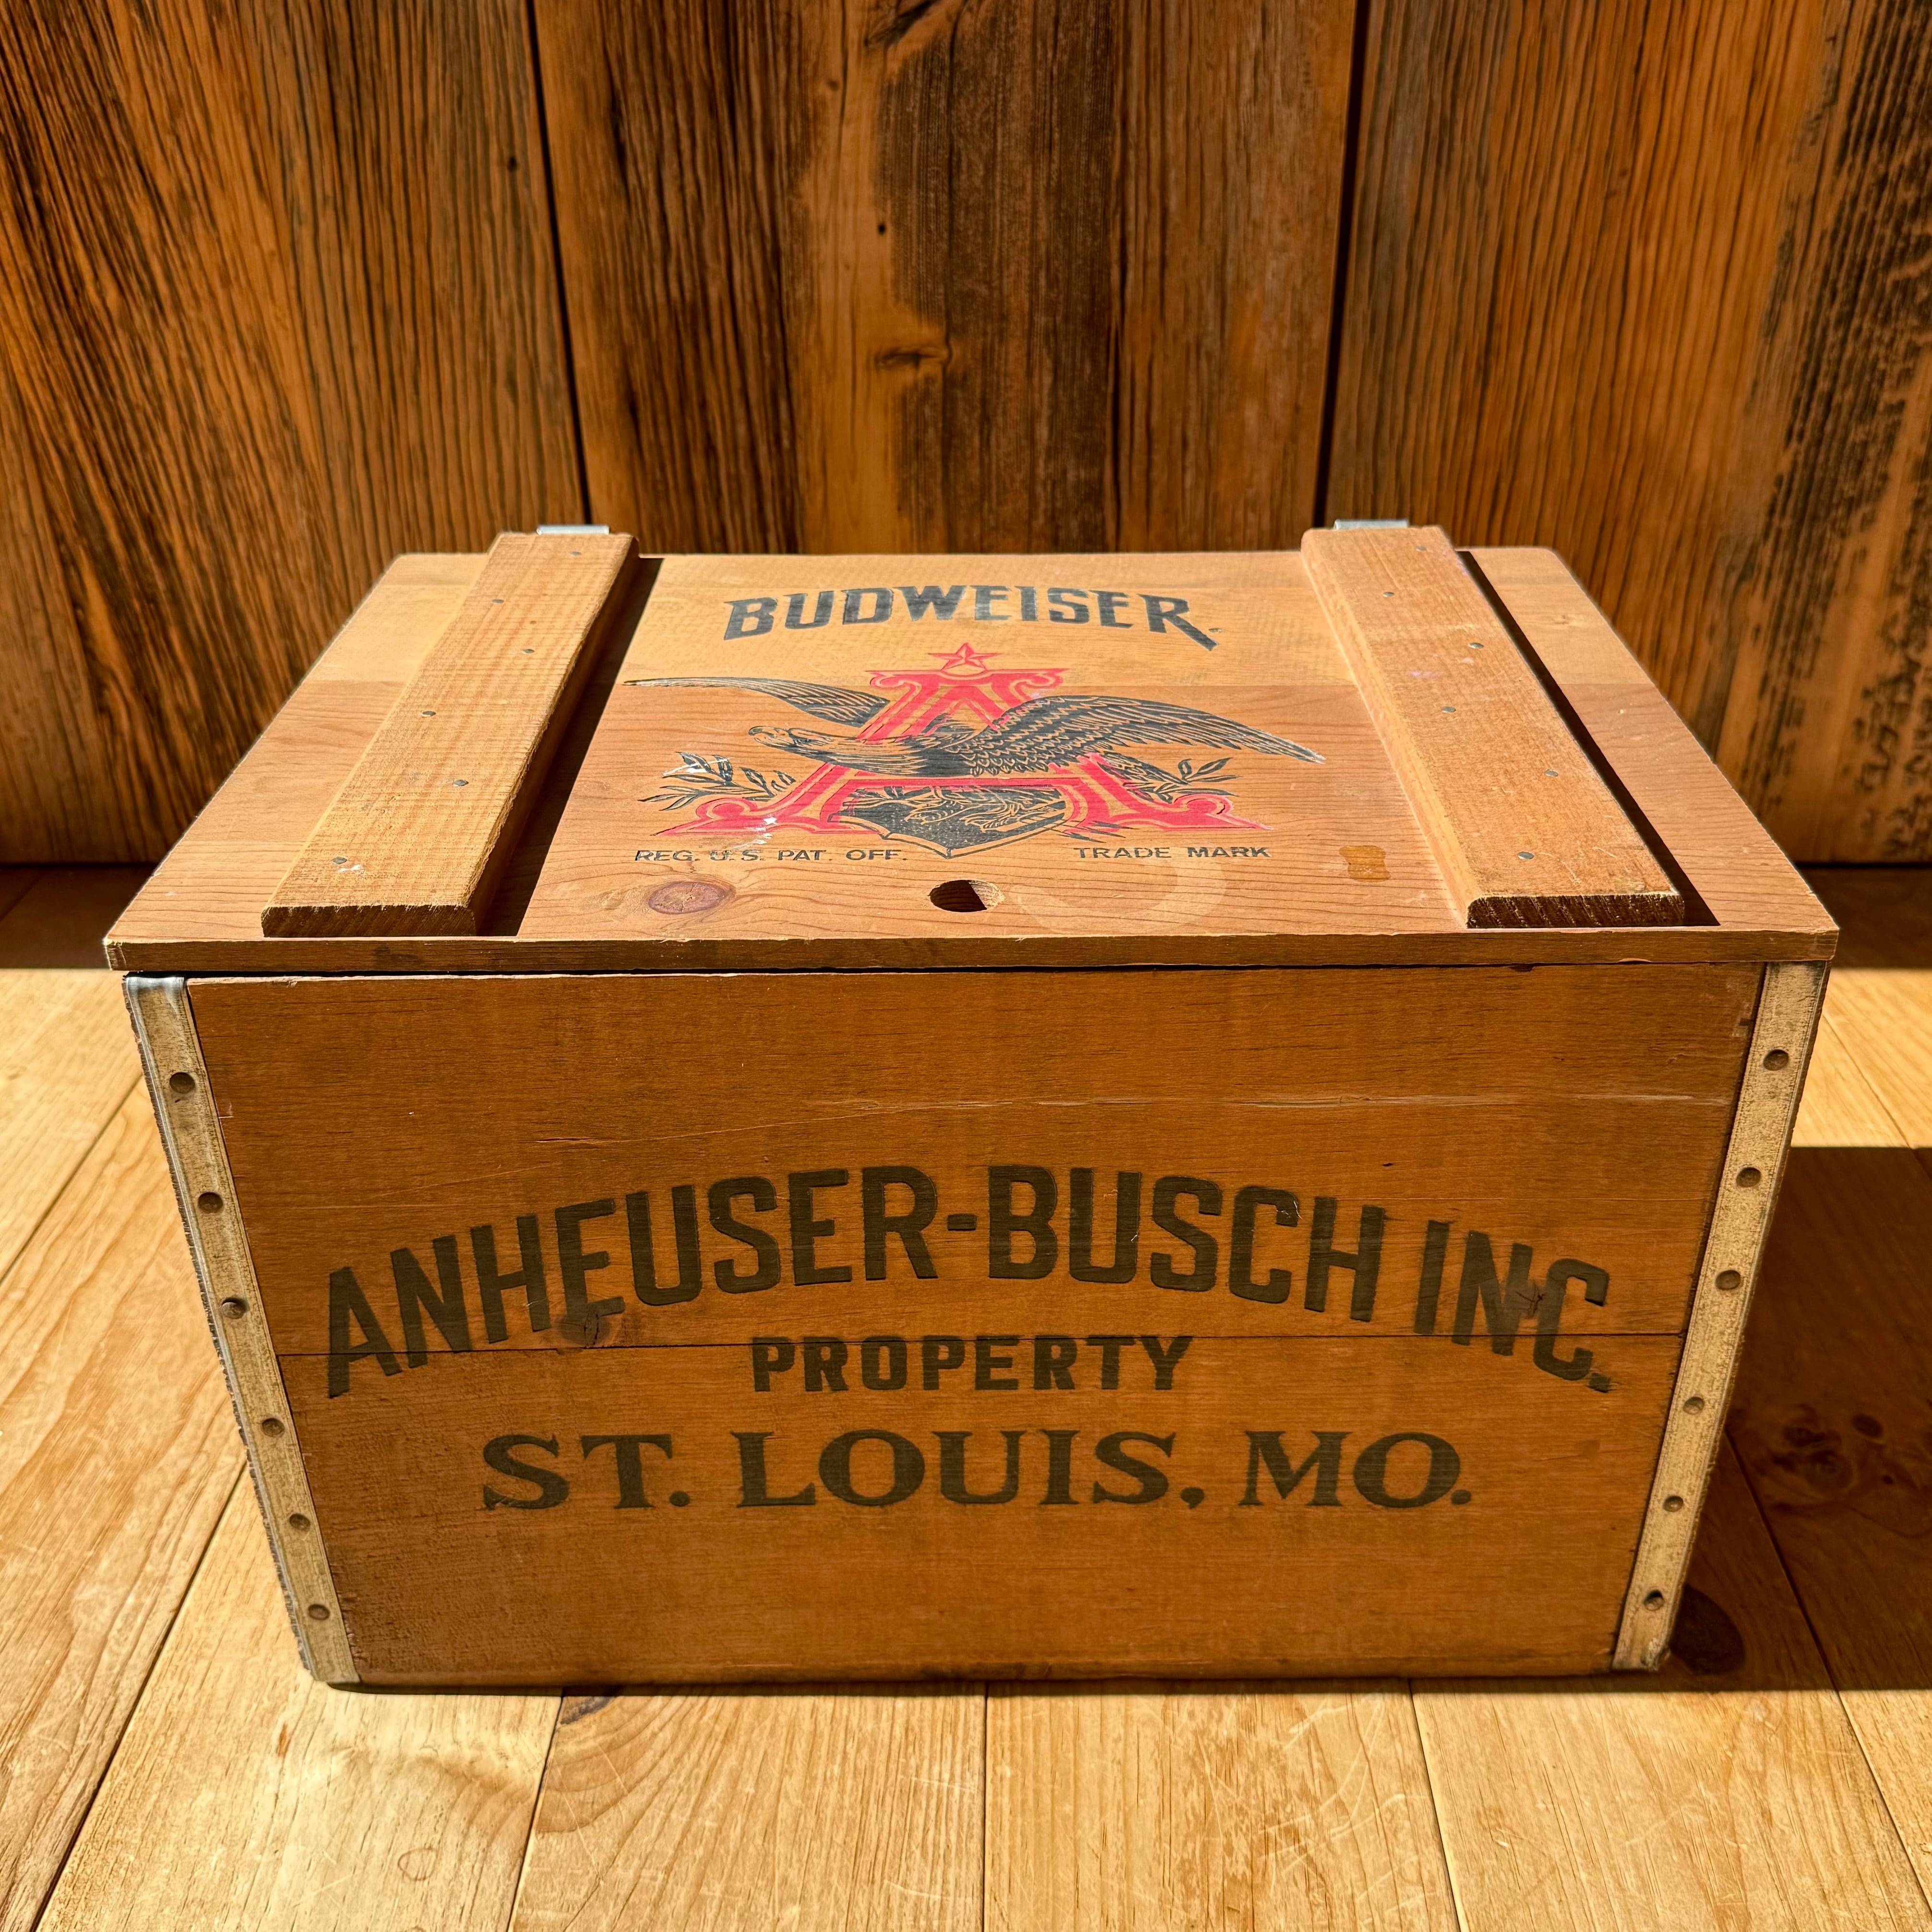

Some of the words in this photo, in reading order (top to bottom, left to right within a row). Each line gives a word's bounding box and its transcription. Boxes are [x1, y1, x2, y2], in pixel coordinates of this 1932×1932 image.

[723, 585, 1218, 651] BUDWEISER
[635, 849, 700, 862] REG.
[778, 849, 833, 861] PAT.
[845, 849, 908, 861] OFF.
[1073, 847, 1172, 859] TRADE
[1187, 847, 1271, 858] MARK
[328, 1165, 1384, 1399] ANHEUSER-BUSCH
[1413, 1219, 1611, 1392] INC.
[752, 1335, 1193, 1392] PROPERTY
[483, 1430, 690, 1510] ST.
[730, 1429, 1205, 1508] LOUIS,
[1237, 1430, 1472, 1509] MO.
